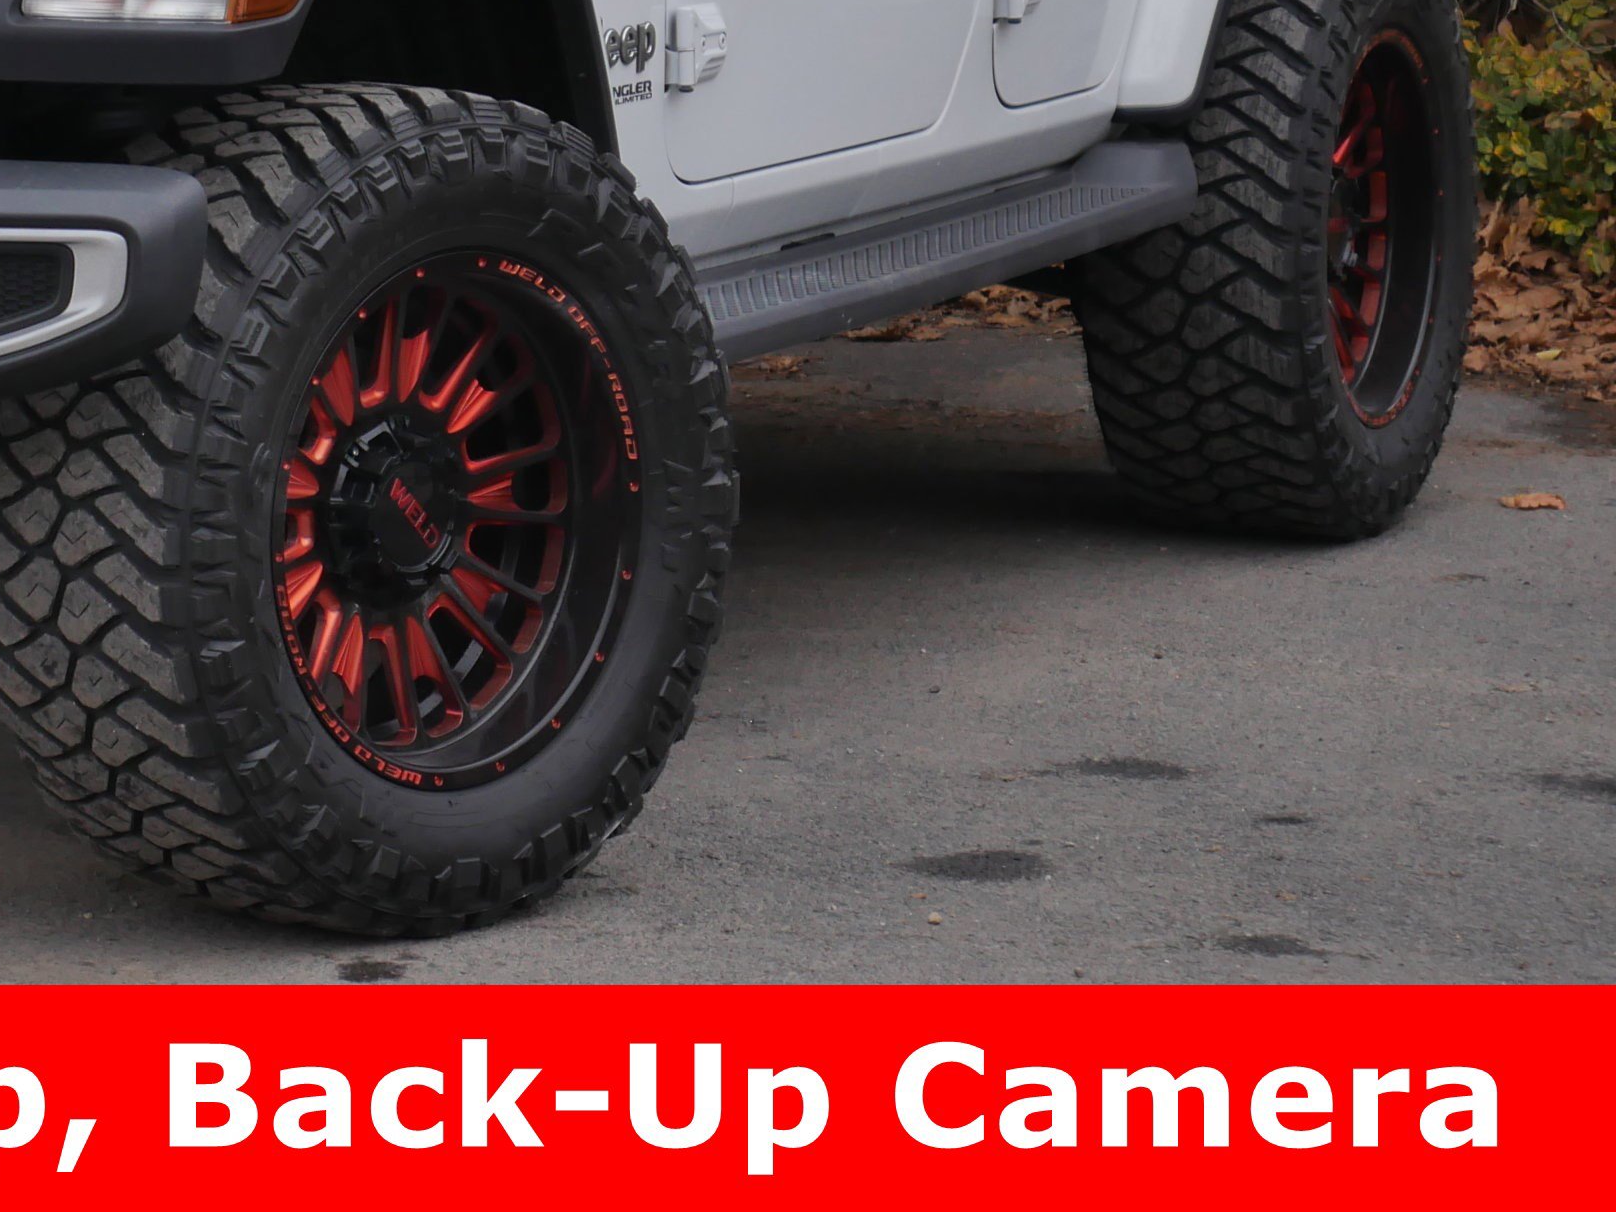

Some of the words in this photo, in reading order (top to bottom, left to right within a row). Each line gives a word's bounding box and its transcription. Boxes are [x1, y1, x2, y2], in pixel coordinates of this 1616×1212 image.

[602, 21, 656, 73] eep
[613, 80, 652, 98] NGLER
[615, 92, 652, 106] LIMITED
[499, 260, 566, 303] WELD
[390, 478, 441, 548] WELD
[353, 744, 422, 785] WELD
